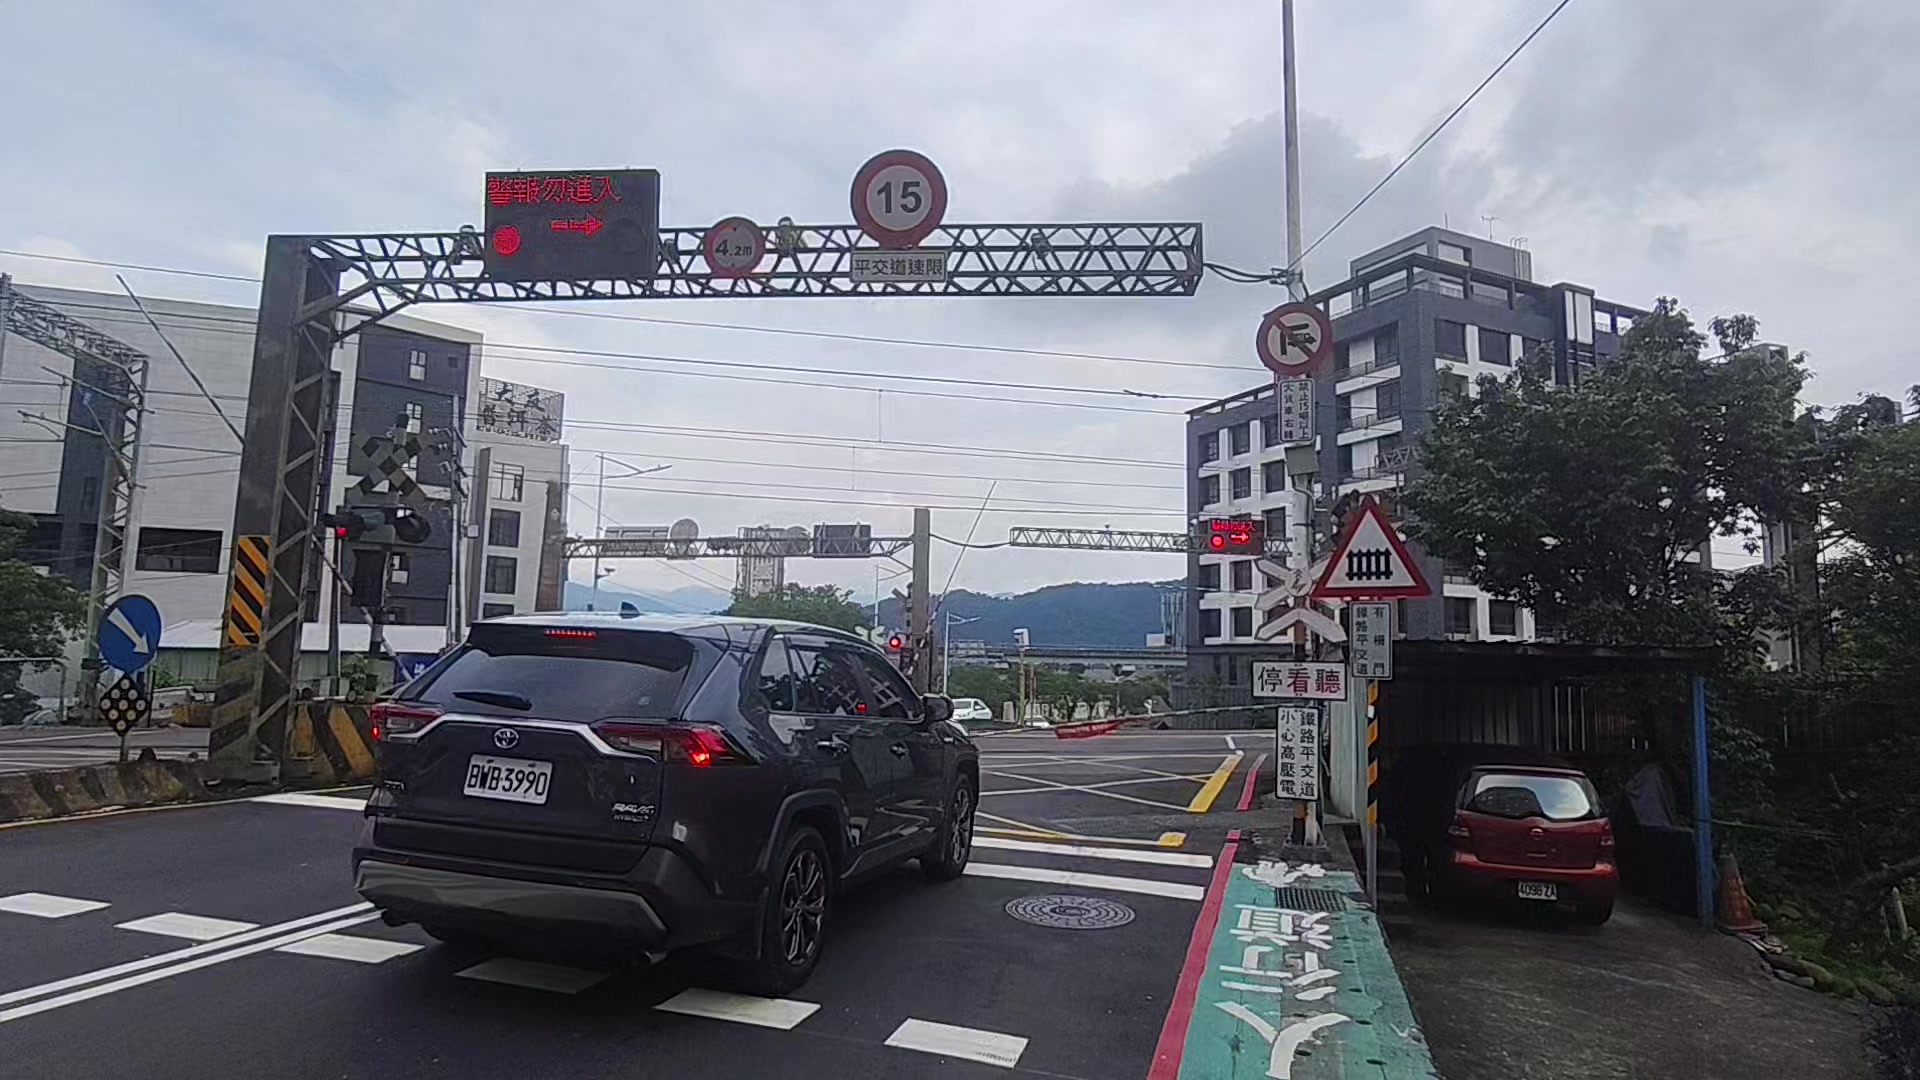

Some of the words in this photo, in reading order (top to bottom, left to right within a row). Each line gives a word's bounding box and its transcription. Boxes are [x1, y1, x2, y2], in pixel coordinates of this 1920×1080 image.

[488, 175, 621, 206] 警報勿進入
[877, 181, 922, 213] 15
[715, 239, 752, 256] 4.2m
[854, 258, 943, 276] 平交道速限
[1257, 666, 1341, 694] 停看聽
[1280, 709, 1297, 797] 小心高壓電
[1300, 711, 1316, 797] 鐵路平交道
